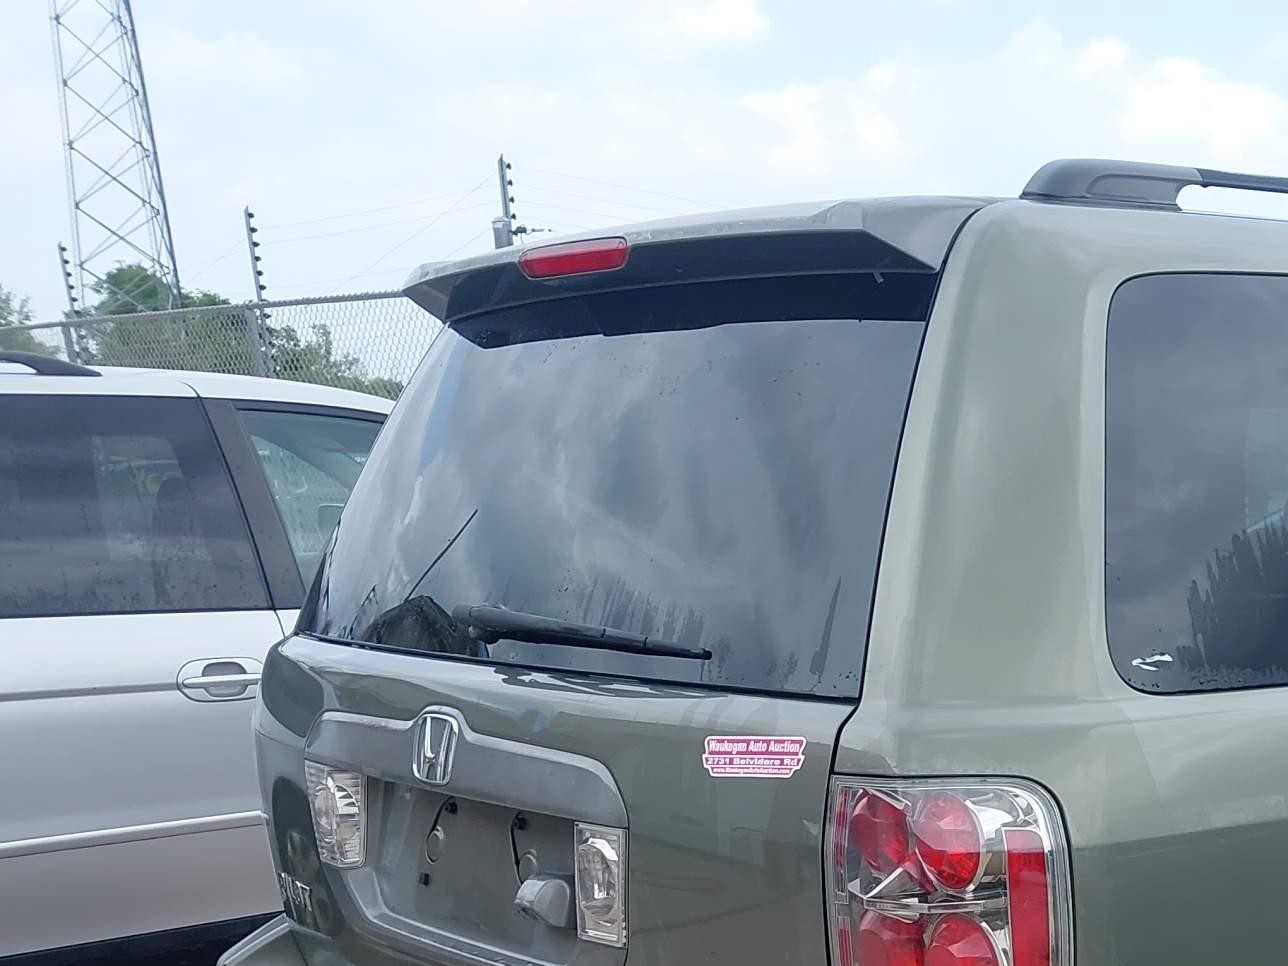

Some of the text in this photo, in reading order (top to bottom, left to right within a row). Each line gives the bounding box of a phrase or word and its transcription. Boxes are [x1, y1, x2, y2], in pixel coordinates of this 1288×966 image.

[749, 741, 767, 753] Auto
[768, 740, 800, 753] Auction
[707, 757, 730, 765] 2731
[784, 758, 798, 766] Rd
